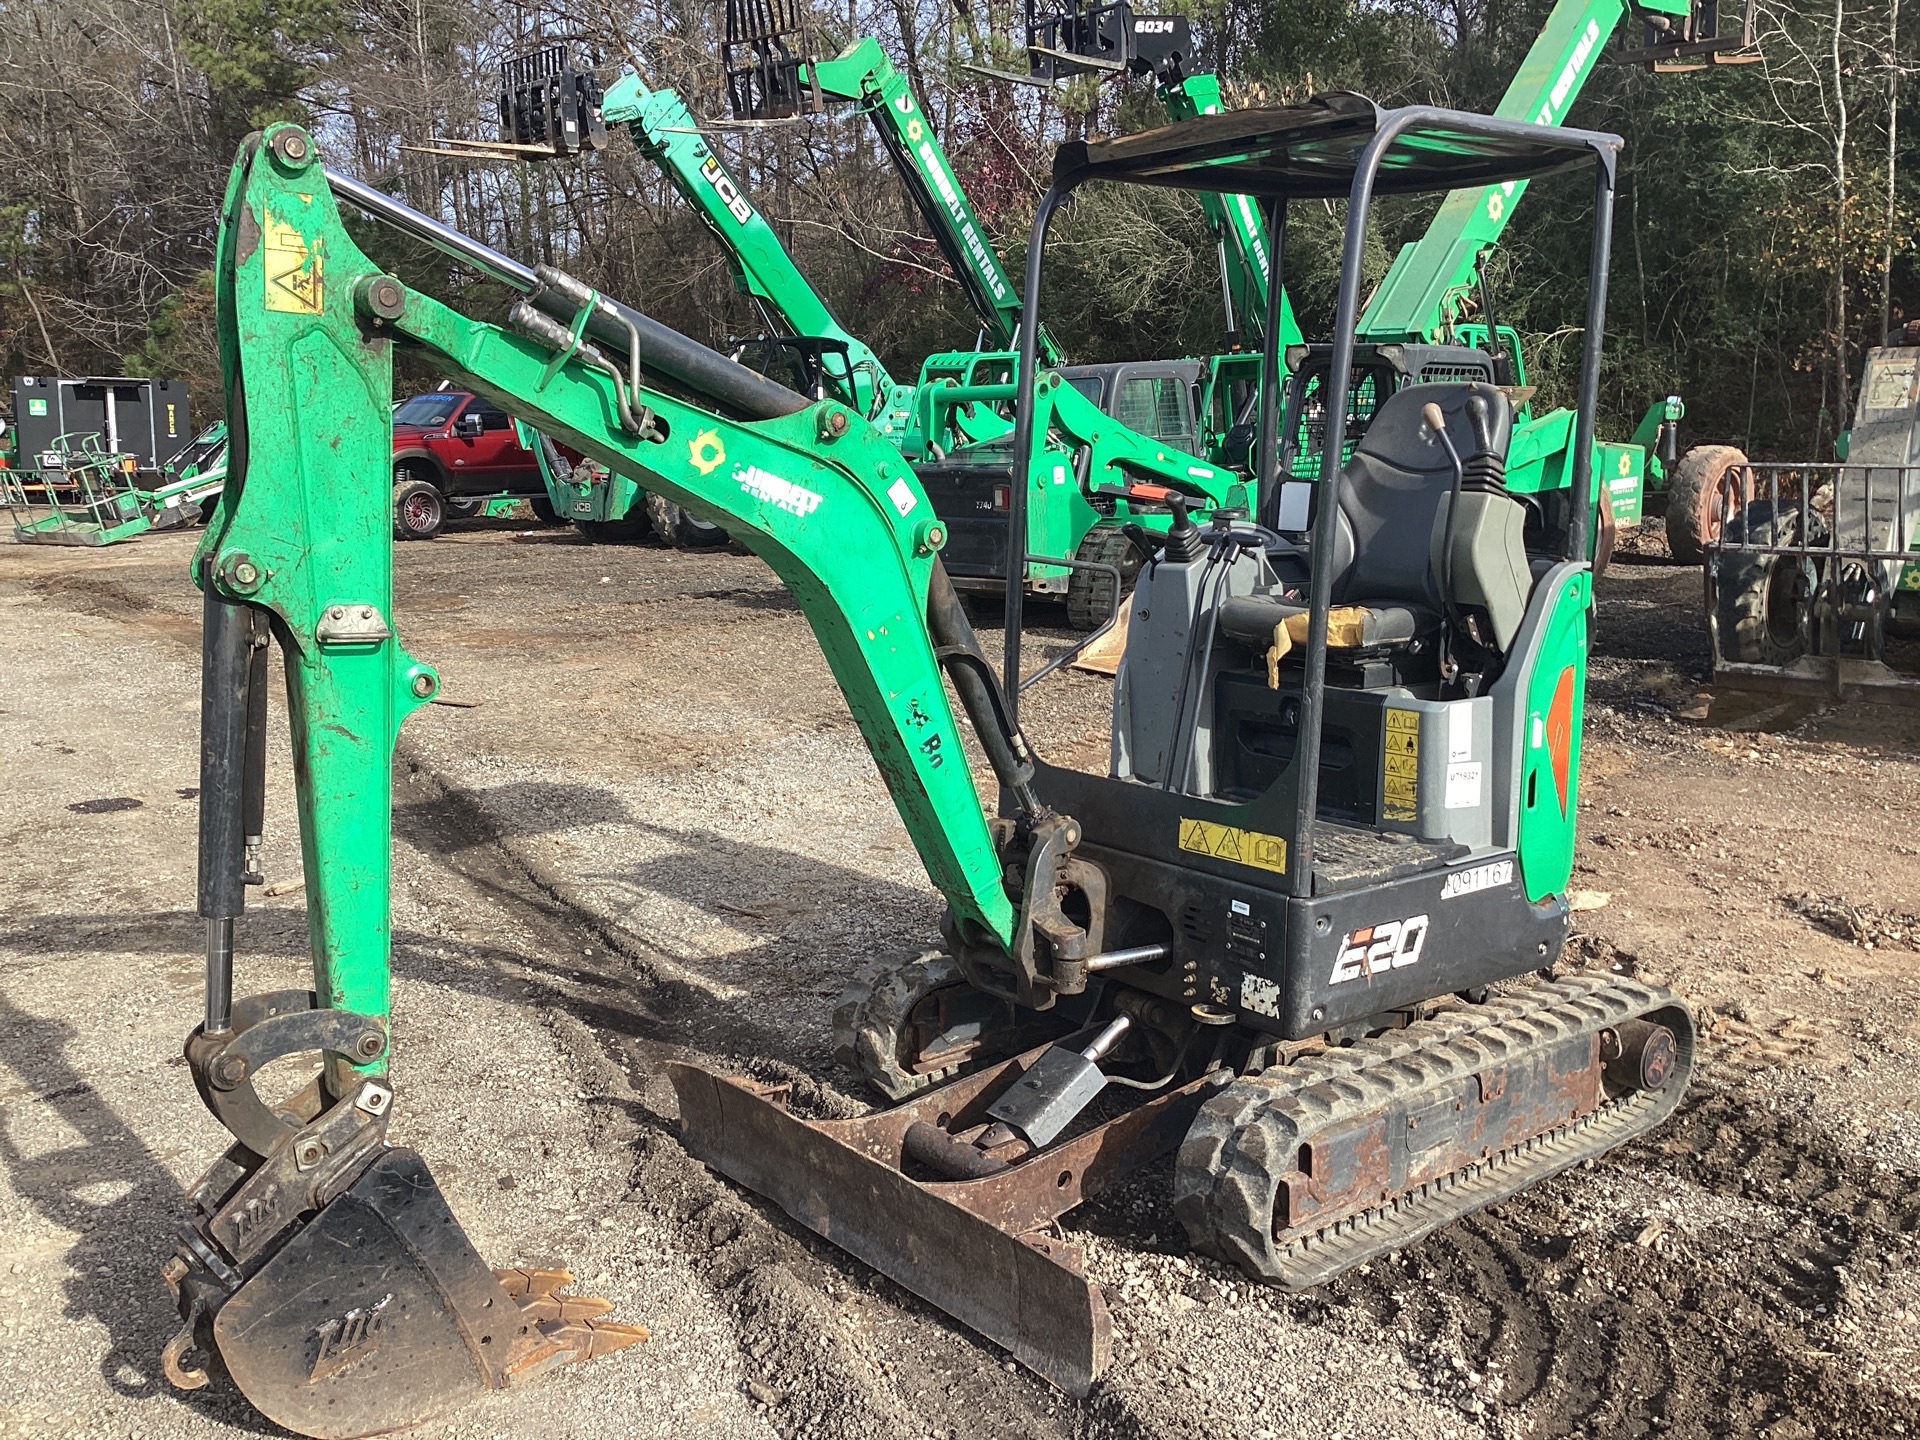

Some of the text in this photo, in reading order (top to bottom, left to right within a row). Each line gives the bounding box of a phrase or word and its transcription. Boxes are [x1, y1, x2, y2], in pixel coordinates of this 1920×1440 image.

[1135, 21, 1174, 33] 6034
[700, 157, 753, 225] JCB
[918, 141, 1006, 300] SUNBELT RENTALS
[573, 503, 592, 513] JCB
[740, 483, 807, 517] RENTALS
[1328, 914, 1429, 986] E20
